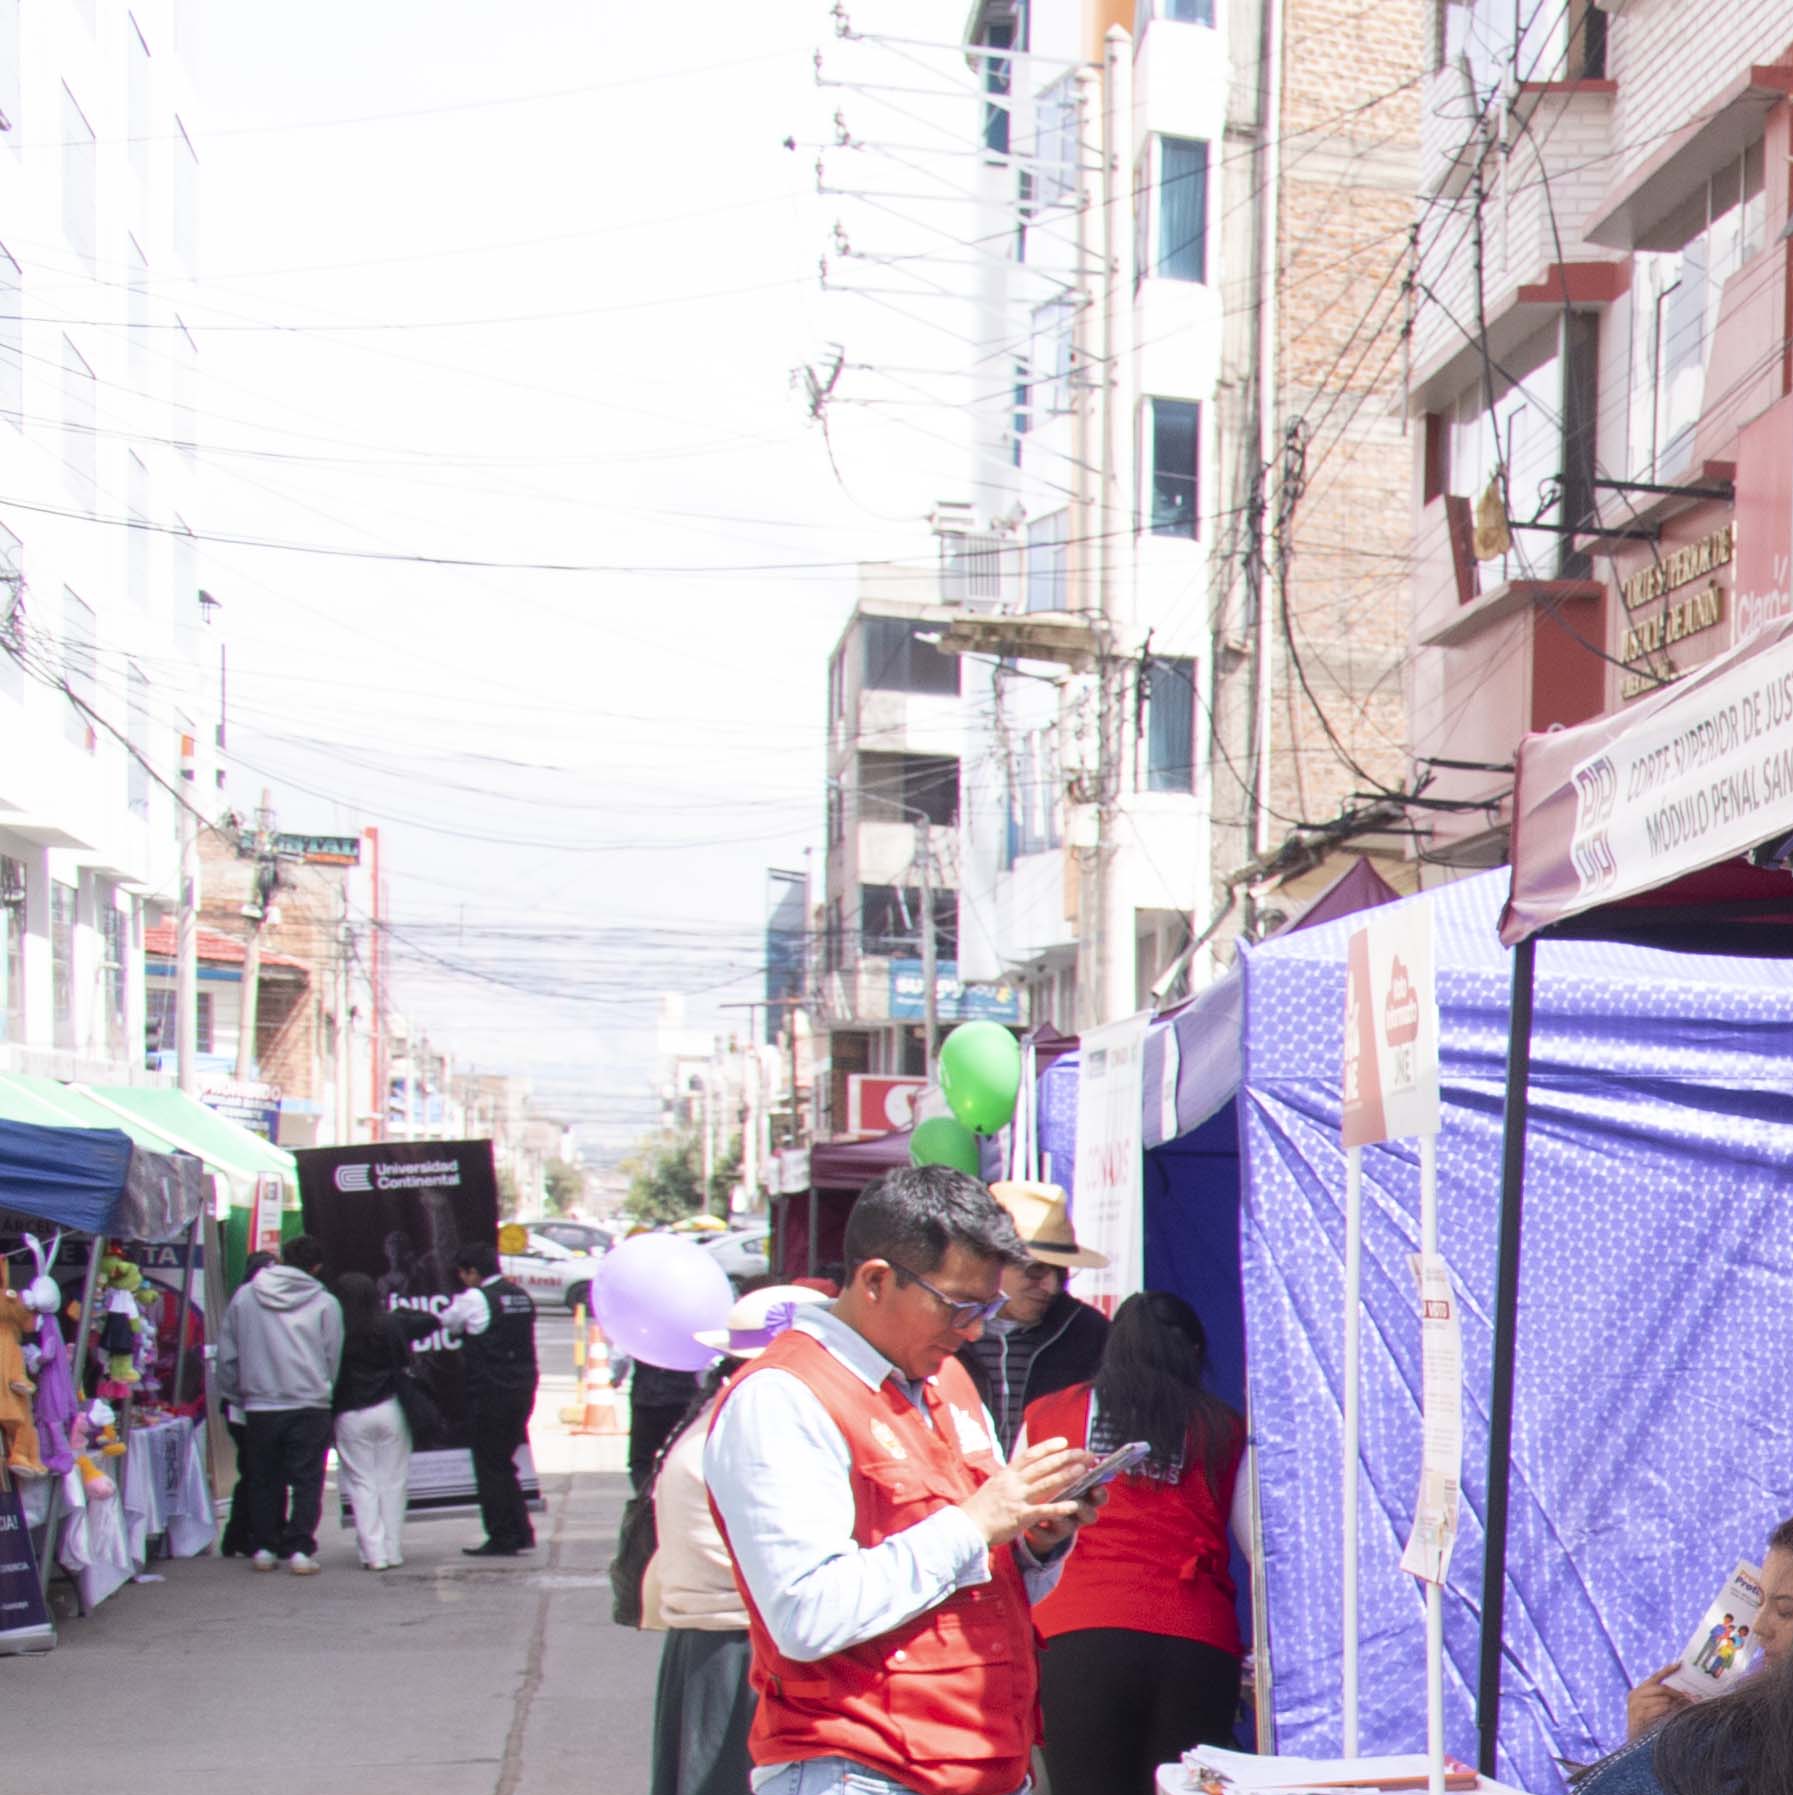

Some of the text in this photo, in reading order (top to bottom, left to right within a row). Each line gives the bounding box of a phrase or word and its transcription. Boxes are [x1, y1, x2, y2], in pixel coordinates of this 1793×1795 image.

[1626, 745, 1671, 803] CORTE
[1673, 704, 1740, 778] SUPERIOR
[1743, 689, 1763, 743] DE
[1645, 788, 1710, 858] MÓDULO
[1712, 763, 1761, 830] PENAL
[375, 1160, 458, 1177] Universidad
[376, 1174, 461, 1190] Continental
